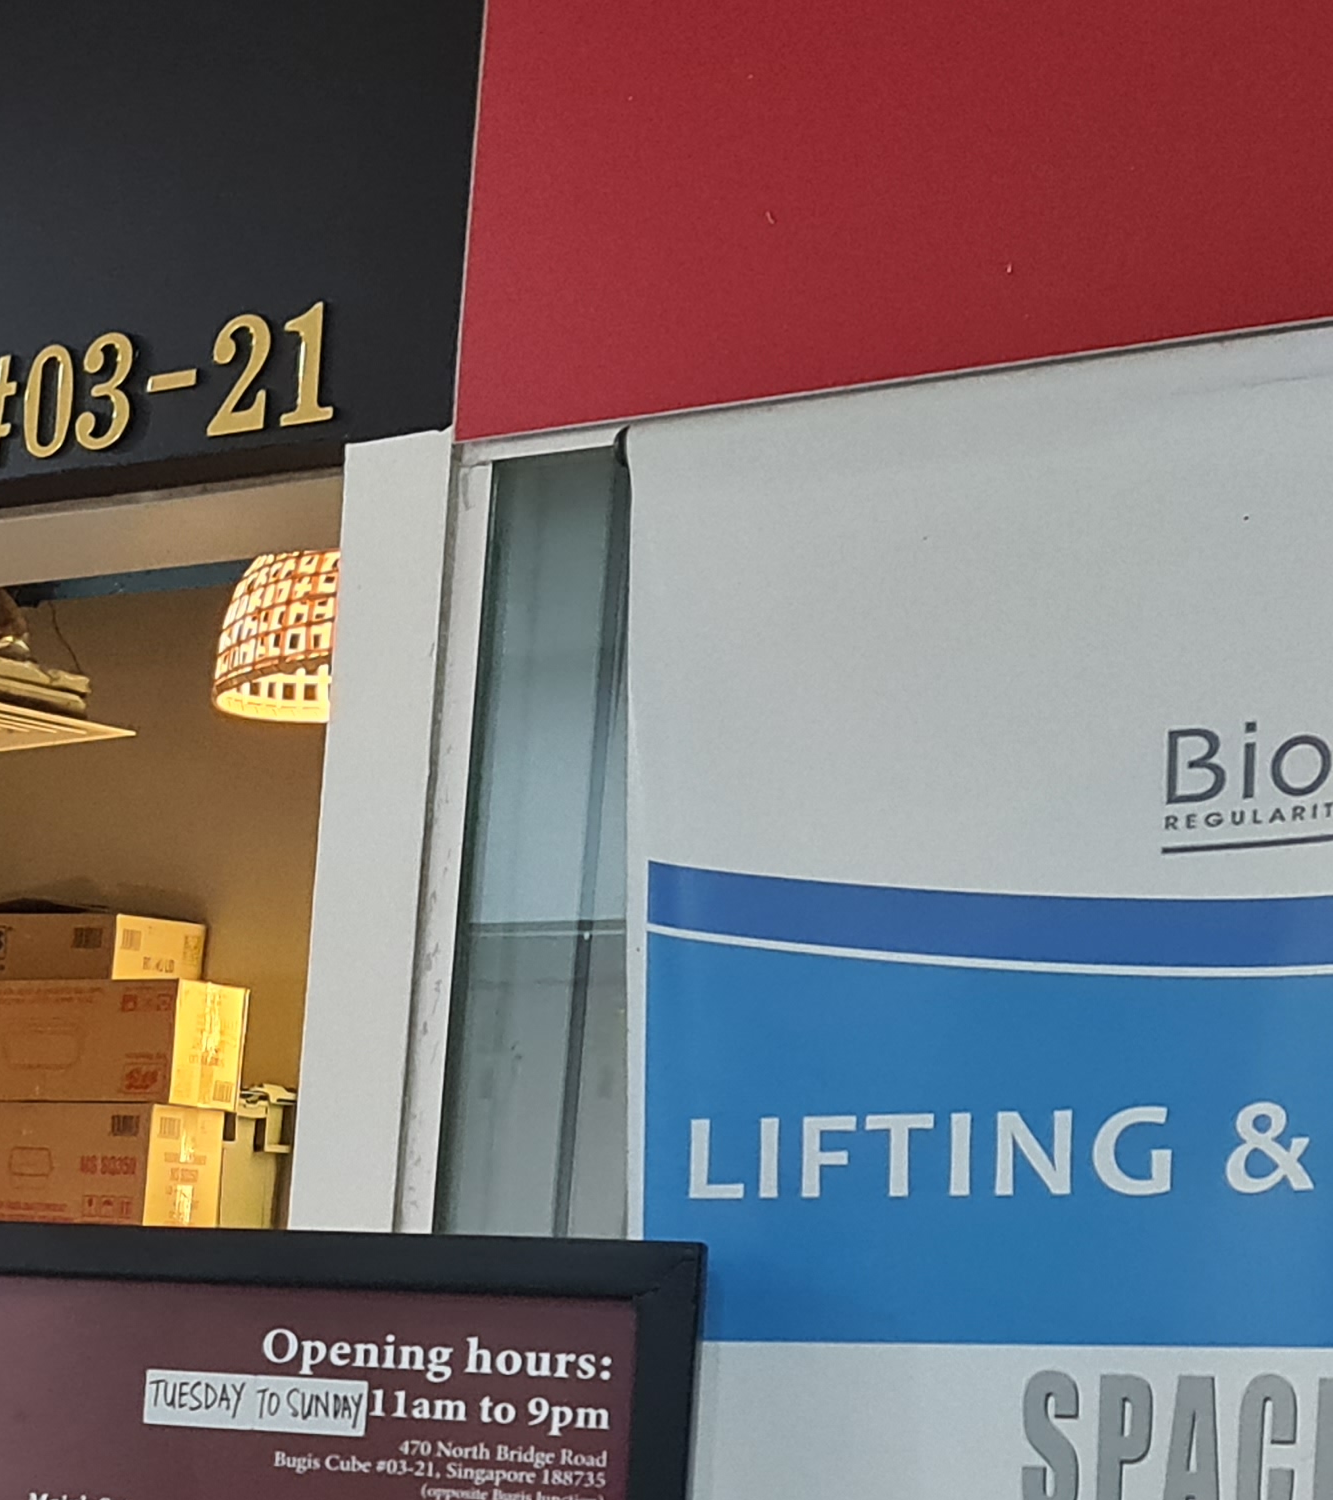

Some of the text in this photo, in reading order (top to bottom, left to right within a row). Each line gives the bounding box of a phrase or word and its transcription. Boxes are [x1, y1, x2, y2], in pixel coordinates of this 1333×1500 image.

[1166, 721, 1332, 805] Bio
[688, 1101, 1314, 1199] LIFTING &
[262, 1328, 612, 1383] Opening hours:
[150, 1379, 364, 1429] TUESDAY TO SUNDAY
[369, 1388, 610, 1436] 11am to 9pm
[274, 1452, 321, 1473] Bugis
[325, 1454, 371, 1474] Cube
[446, 1462, 536, 1485] Singapore
[541, 1469, 606, 1488] 188735
[399, 1440, 607, 1468] 470 North Bridge Road
